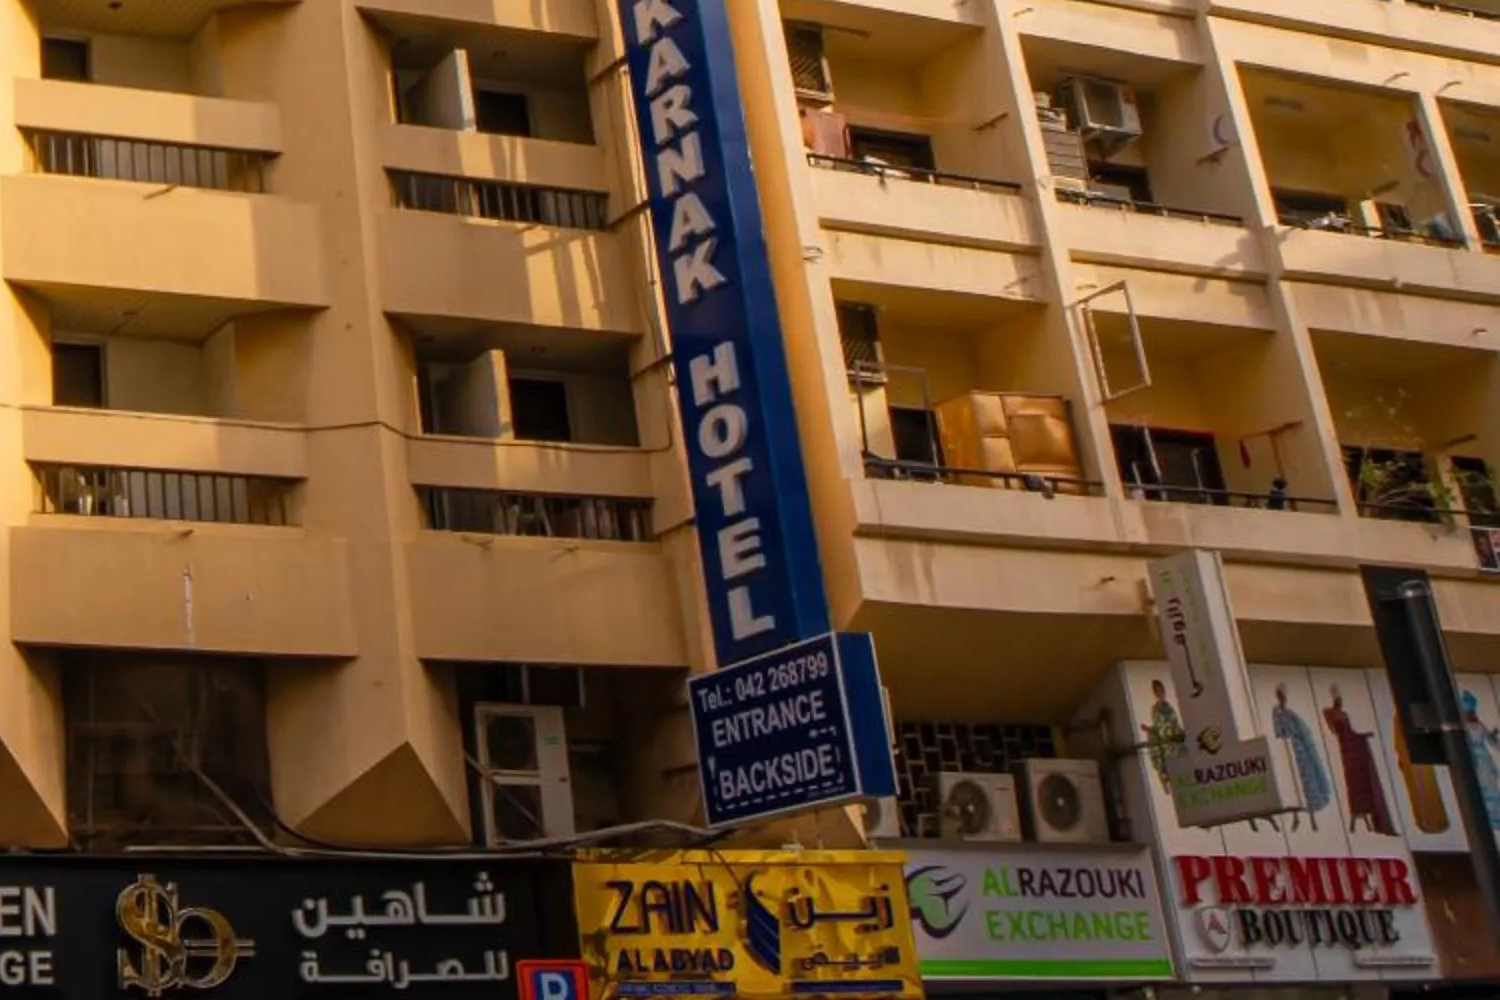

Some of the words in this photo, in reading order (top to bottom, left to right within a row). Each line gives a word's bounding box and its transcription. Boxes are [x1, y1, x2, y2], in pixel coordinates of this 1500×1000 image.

[688, 339, 776, 643] HOTEL
[734, 671, 766, 702] 042
[768, 651, 829, 694] 268799
[711, 689, 827, 748] ENTRANCE
[718, 743, 836, 801] BACKSIDE
[291, 871, 507, 940] شاهين
[1171, 855, 1417, 906] PREMIER
[605, 880, 719, 934] ZAIN
[787, 884, 894, 930] زين
[985, 909, 1155, 941] EXCHANGE
[1236, 908, 1401, 949] BOUTIQUE
[298, 948, 510, 990] للصرافة
[540, 971, 569, 1000] P
[617, 947, 649, 973] AL
[653, 947, 735, 972] ABYAD
